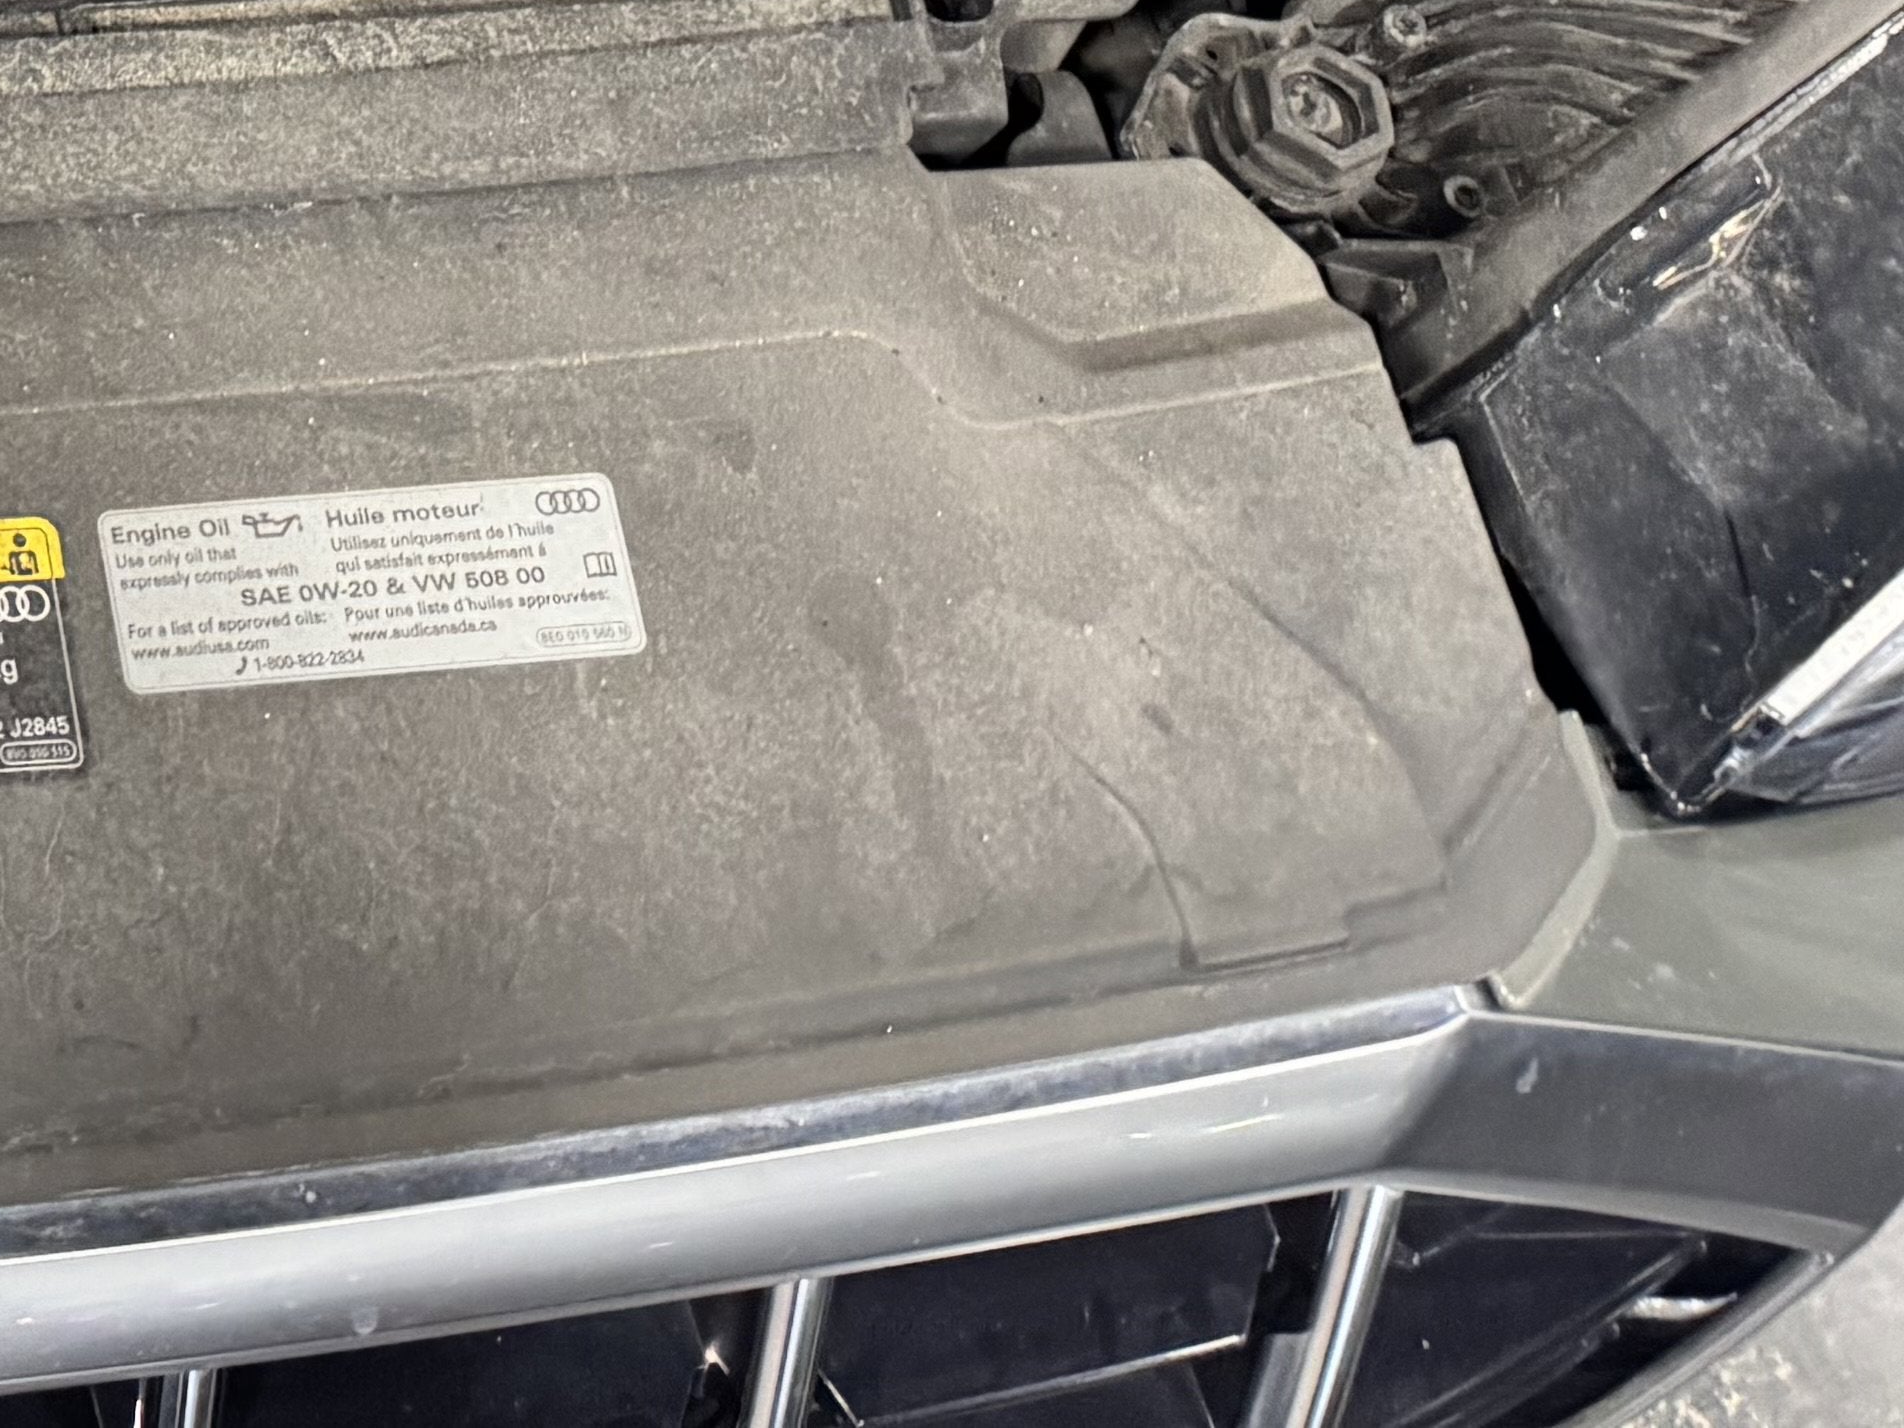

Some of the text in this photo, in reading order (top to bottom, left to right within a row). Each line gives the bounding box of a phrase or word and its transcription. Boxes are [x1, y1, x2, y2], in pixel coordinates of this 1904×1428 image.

[324, 501, 482, 527] Huile moteur
[110, 518, 230, 548] Engine Oil
[329, 534, 386, 551] Utilisez
[389, 527, 483, 552] uniquement
[484, 525, 505, 538] de
[114, 546, 236, 569] Use only oil that
[335, 557, 361, 573] qui
[363, 552, 423, 569] satisfait
[119, 562, 299, 591] expressly complies with
[239, 566, 546, 606] SAE 0W-20 & VW 508 00
[344, 605, 380, 621] Pour
[384, 605, 414, 618] une
[416, 600, 449, 615] liste
[126, 609, 327, 638] For a list of approved oils:
[347, 617, 498, 642] www.audicanada.ca
[131, 637, 271, 660] www.audiusa.com
[9, 715, 69, 737] J2845
